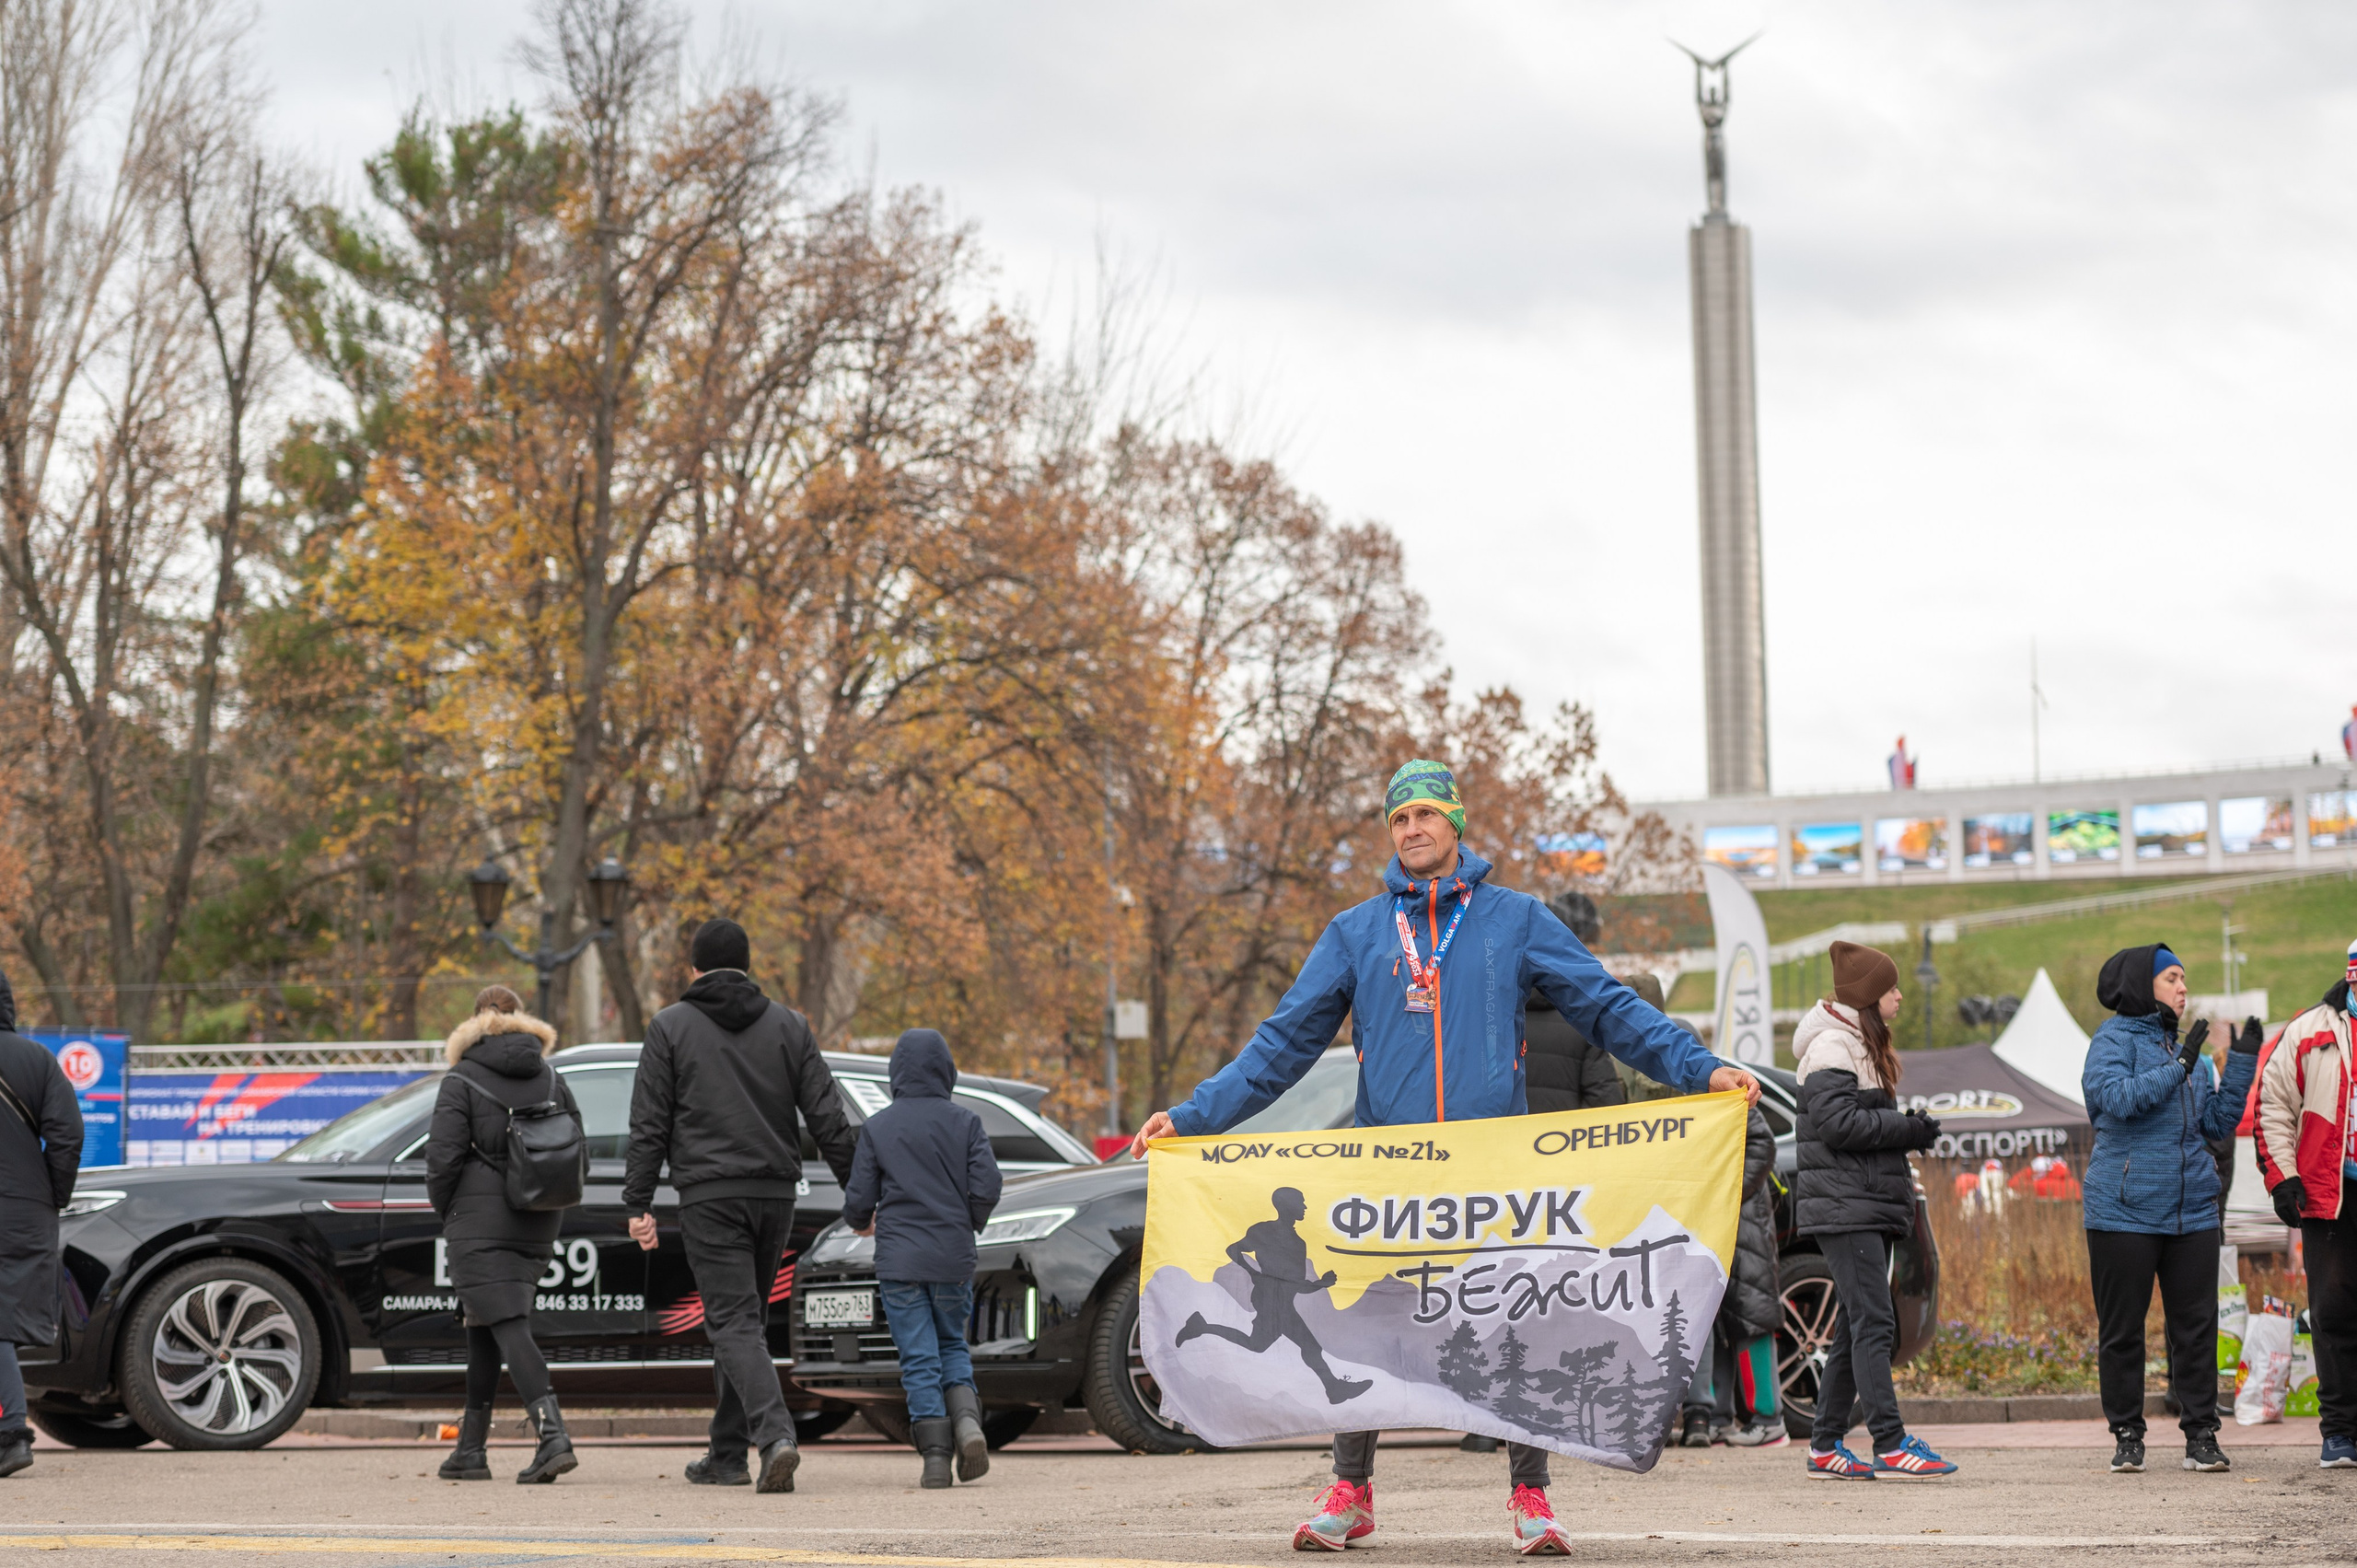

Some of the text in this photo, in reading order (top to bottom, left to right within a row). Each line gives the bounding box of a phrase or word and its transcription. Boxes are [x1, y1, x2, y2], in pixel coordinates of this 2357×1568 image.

[1483, 937, 1496, 1024] SAXIFRAGA
[68, 1054, 92, 1074] 10
[128, 1102, 195, 1120] СТАВАЙ
[198, 1105, 212, 1120] И
[214, 1104, 258, 1120] БЕГИ
[198, 1119, 331, 1135] НА ТРЕНИРОВК
[1533, 1117, 1695, 1156] ОРЕНБУРГ
[1201, 1143, 1274, 1165] МОАУ
[1928, 1128, 2069, 1158] ОСПОРТ!»
[1331, 1190, 1584, 1240] ФИЗРУК
[382, 1294, 644, 1311] САМАРА-М 846 33 17 333
